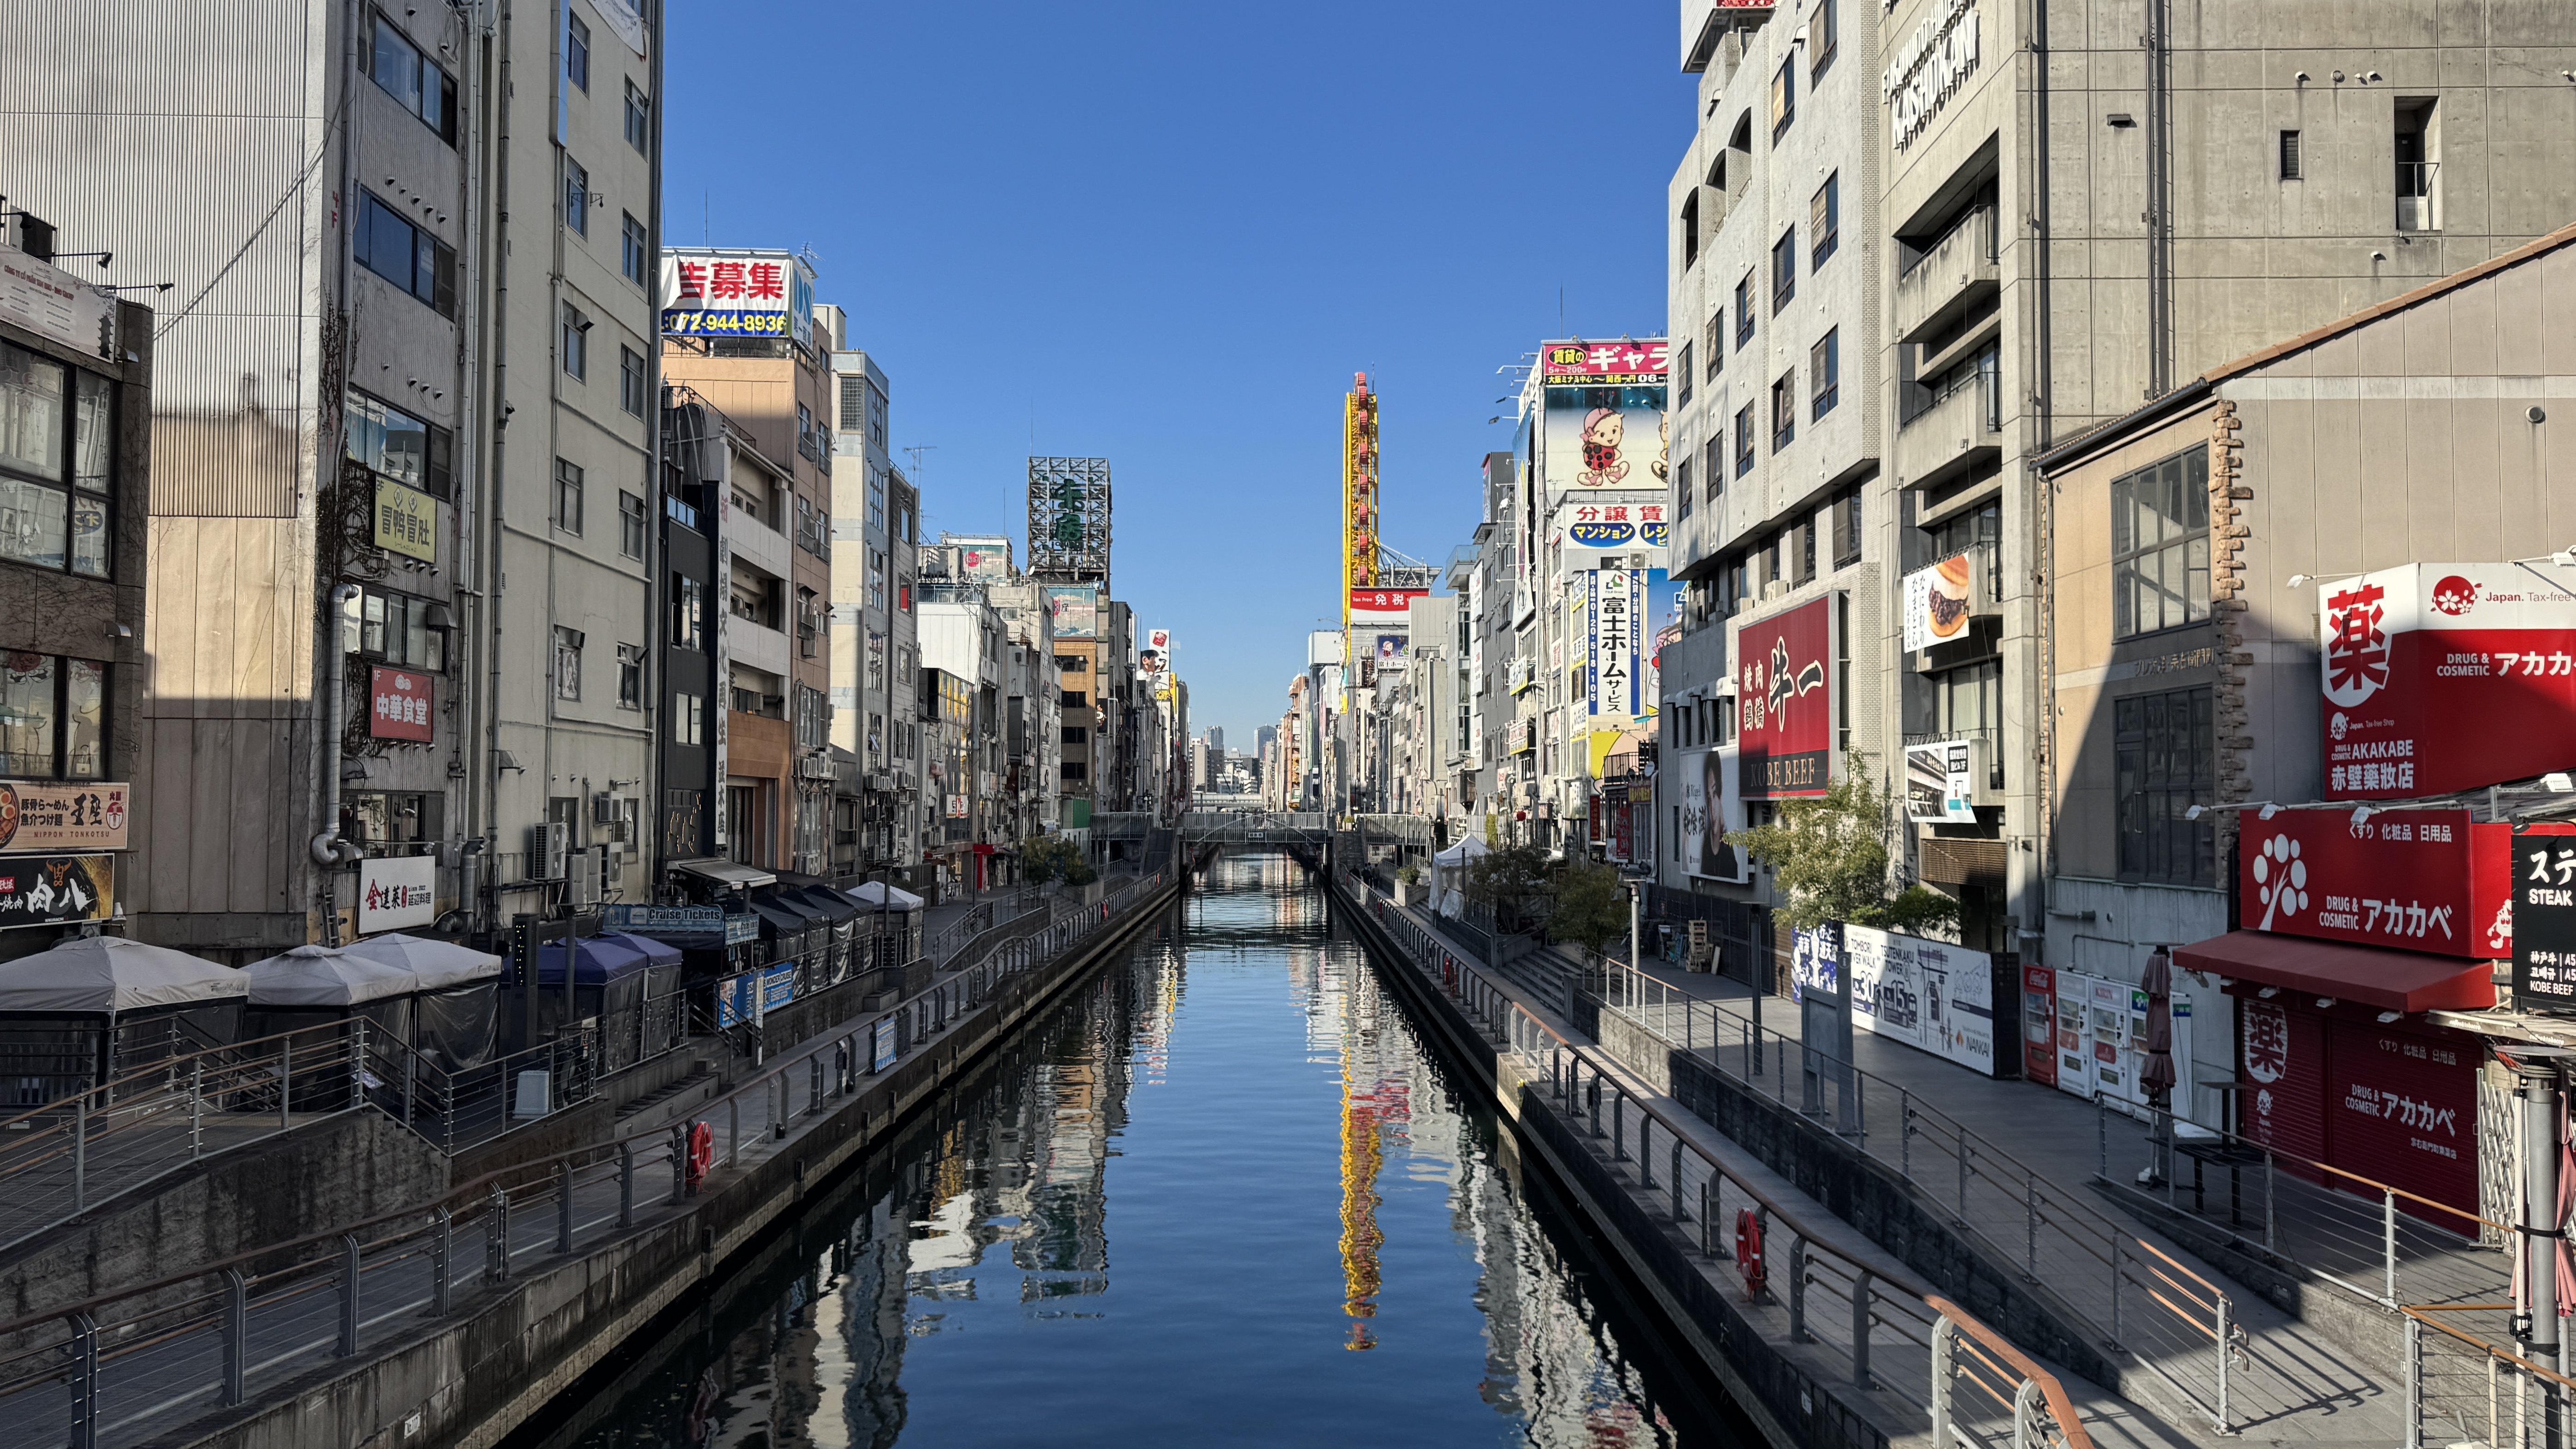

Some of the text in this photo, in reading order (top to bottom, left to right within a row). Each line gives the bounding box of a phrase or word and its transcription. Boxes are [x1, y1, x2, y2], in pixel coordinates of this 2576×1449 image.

[1893, 8, 1979, 149] KASHOKAN
[1553, 349, 1585, 364] 賃貸の
[1576, 506, 1628, 521] 分譲
[1574, 525, 1633, 539] マンション
[2485, 591, 2571, 603] Japan. Tax-free
[2328, 583, 2388, 693] 薬
[1602, 597, 1627, 712] 富士ホームサービス
[2447, 654, 2489, 664] DRUG &
[374, 670, 381, 681] 1F
[1744, 659, 1763, 692] 焼肉
[2437, 665, 2490, 677] COSMETIC
[1768, 635, 1824, 733] 牛一
[377, 693, 427, 725] 中華食堂
[2349, 722, 2364, 731] Japan.
[2383, 718, 2395, 728] Shop
[2331, 752, 2351, 761] COSMETIC
[2334, 744, 2347, 753] DRUG
[2352, 739, 2414, 760] AKAKABE
[1751, 757, 1815, 787] KOBE BEEF
[2349, 823, 2452, 844] くすり 化粧品 日用品
[2326, 895, 2359, 913] DRUG &
[2529, 888, 2573, 907] STEAK
[648, 908, 721, 921] Cruise Tickets
[2319, 911, 2359, 931] COSMETIC
[2362, 898, 2453, 941] アカカベ
[1851, 938, 1872, 954] TOMBORI
[1880, 944, 1914, 964] TSUTENKAKU
[1863, 954, 1876, 968] WALK
[1885, 959, 1903, 975] TOWER
[2530, 950, 2557, 966] 神戸牛
[2095, 987, 2113, 1000] KIRIN
[2530, 980, 2574, 996] KOBE BEEF
[1966, 1036, 1991, 1058] NANKAI
[2379, 1038, 2457, 1066] くすり 化粧品 日用品
[2352, 1084, 2379, 1102] DRUG &
[2346, 1096, 2380, 1117] COSMETIC
[2381, 1091, 2456, 1138] アカカベ
